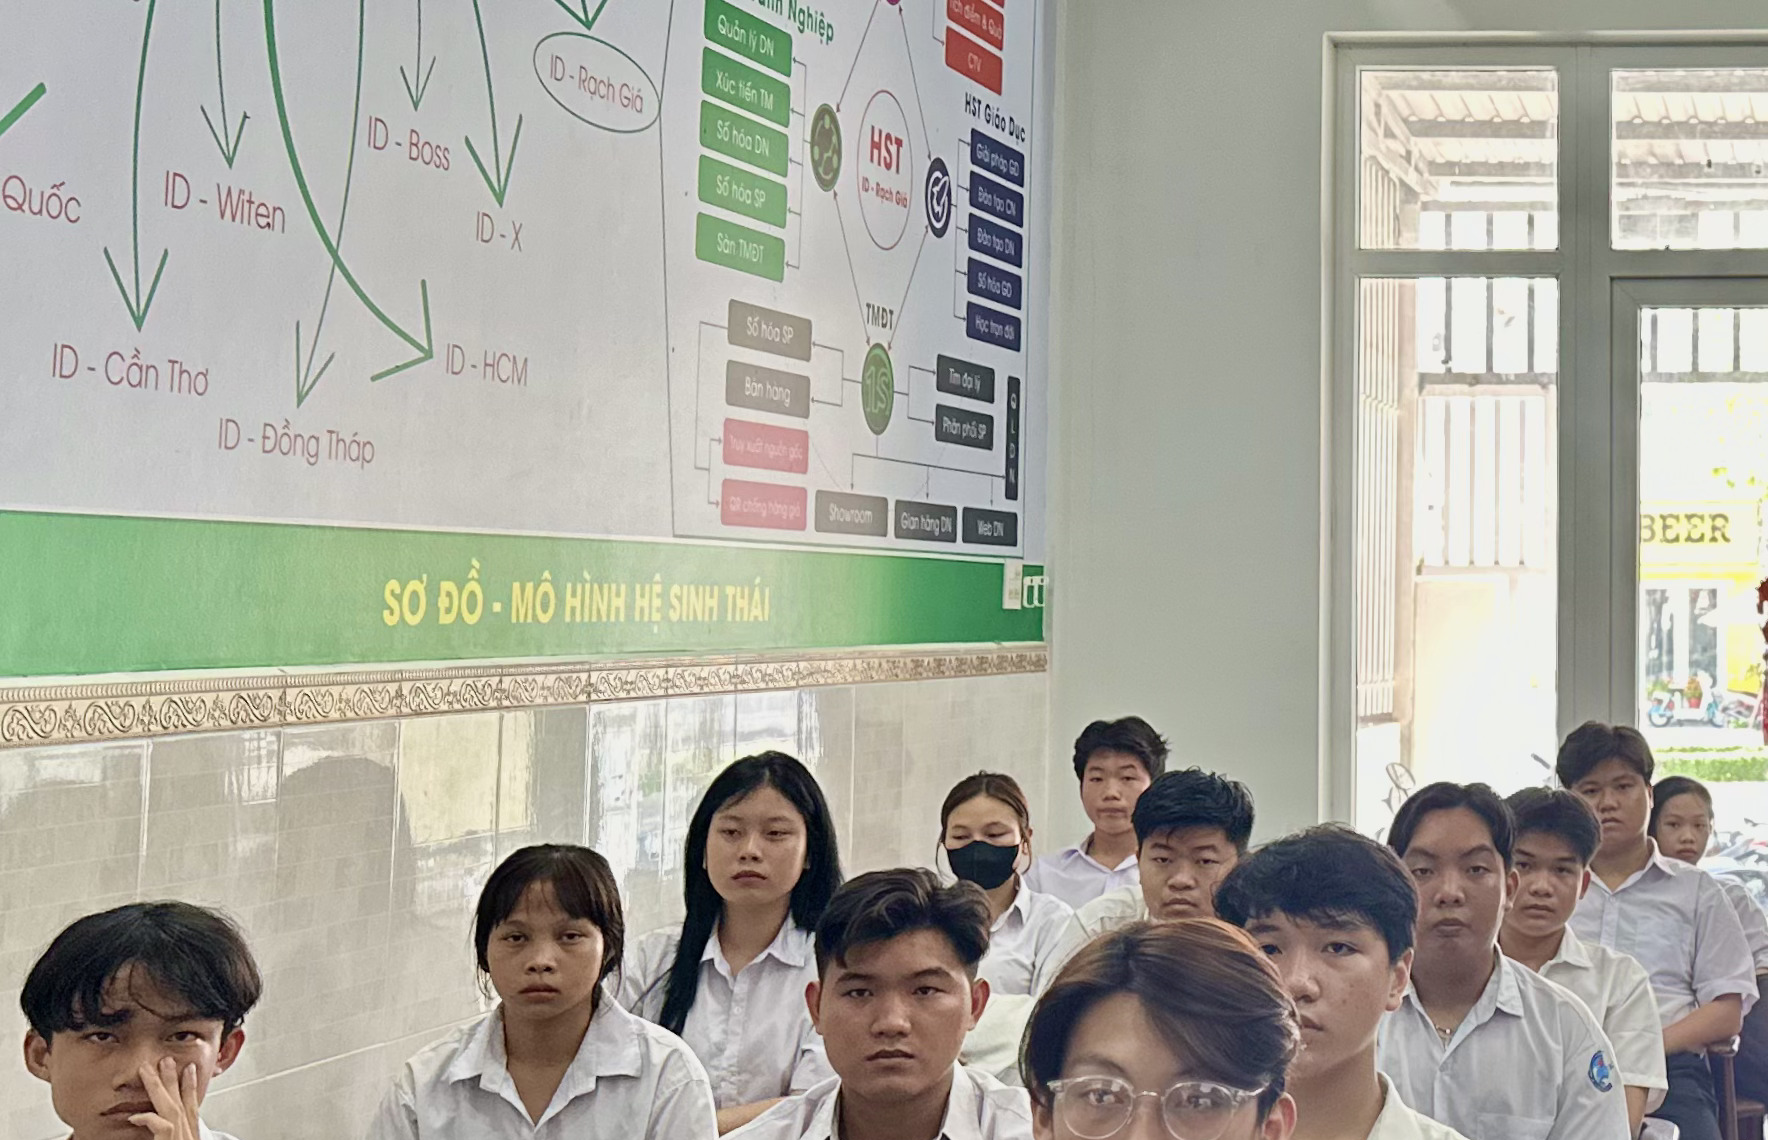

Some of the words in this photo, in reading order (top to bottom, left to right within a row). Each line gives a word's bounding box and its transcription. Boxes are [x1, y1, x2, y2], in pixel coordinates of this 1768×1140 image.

[718, 15, 746, 43] Quản
[760, 35, 774, 58] DN
[549, 55, 566, 82] ID
[577, 66, 616, 102] Rạch
[618, 80, 644, 114] Giá
[760, 89, 774, 112] TM
[717, 120, 730, 141] Số
[732, 128, 752, 150] hóa
[755, 135, 770, 157] DN
[965, 91, 982, 119] HST
[985, 103, 1006, 132] Giáo
[1009, 116, 1026, 145] Dục
[367, 116, 389, 152] ID
[409, 128, 451, 171] Boss
[870, 125, 903, 174] HST
[2, 175, 81, 224] Quốc
[164, 170, 191, 210] ID
[216, 183, 286, 234] Witen
[716, 175, 730, 196] Số
[732, 183, 752, 204] hóa
[754, 189, 766, 209] SP
[862, 176, 870, 194] ID
[876, 182, 894, 205] Rạch
[895, 190, 908, 209] Giá
[476, 211, 494, 244] ID
[511, 221, 523, 252] X
[717, 232, 736, 256] Sàn
[739, 239, 764, 263] TMĐT
[746, 315, 759, 337] Số
[761, 321, 780, 342] hóa
[782, 325, 794, 344] SP
[866, 302, 894, 330] TMĐT
[52, 343, 79, 379] ID
[105, 347, 159, 391] Cần
[168, 359, 209, 397] Thơ
[445, 342, 465, 376] ID
[482, 349, 529, 387] HCM
[745, 376, 763, 397] Bán
[766, 380, 791, 408] hàng
[218, 417, 241, 450] ID
[261, 418, 320, 466] Đồng
[326, 429, 376, 470] Tháp
[829, 503, 873, 524] Showroom
[901, 511, 920, 530] Gian
[941, 516, 952, 533] DN
[993, 521, 1004, 537] DN
[1640, 513, 1731, 543] BEER
[383, 573, 427, 626] SƠ
[437, 557, 483, 625] ĐỒ
[511, 570, 556, 624] MÔ
[565, 570, 626, 623] HÌNH
[635, 573, 663, 633] HỆ
[668, 583, 719, 623] SINH
[725, 576, 771, 622] THÁI
